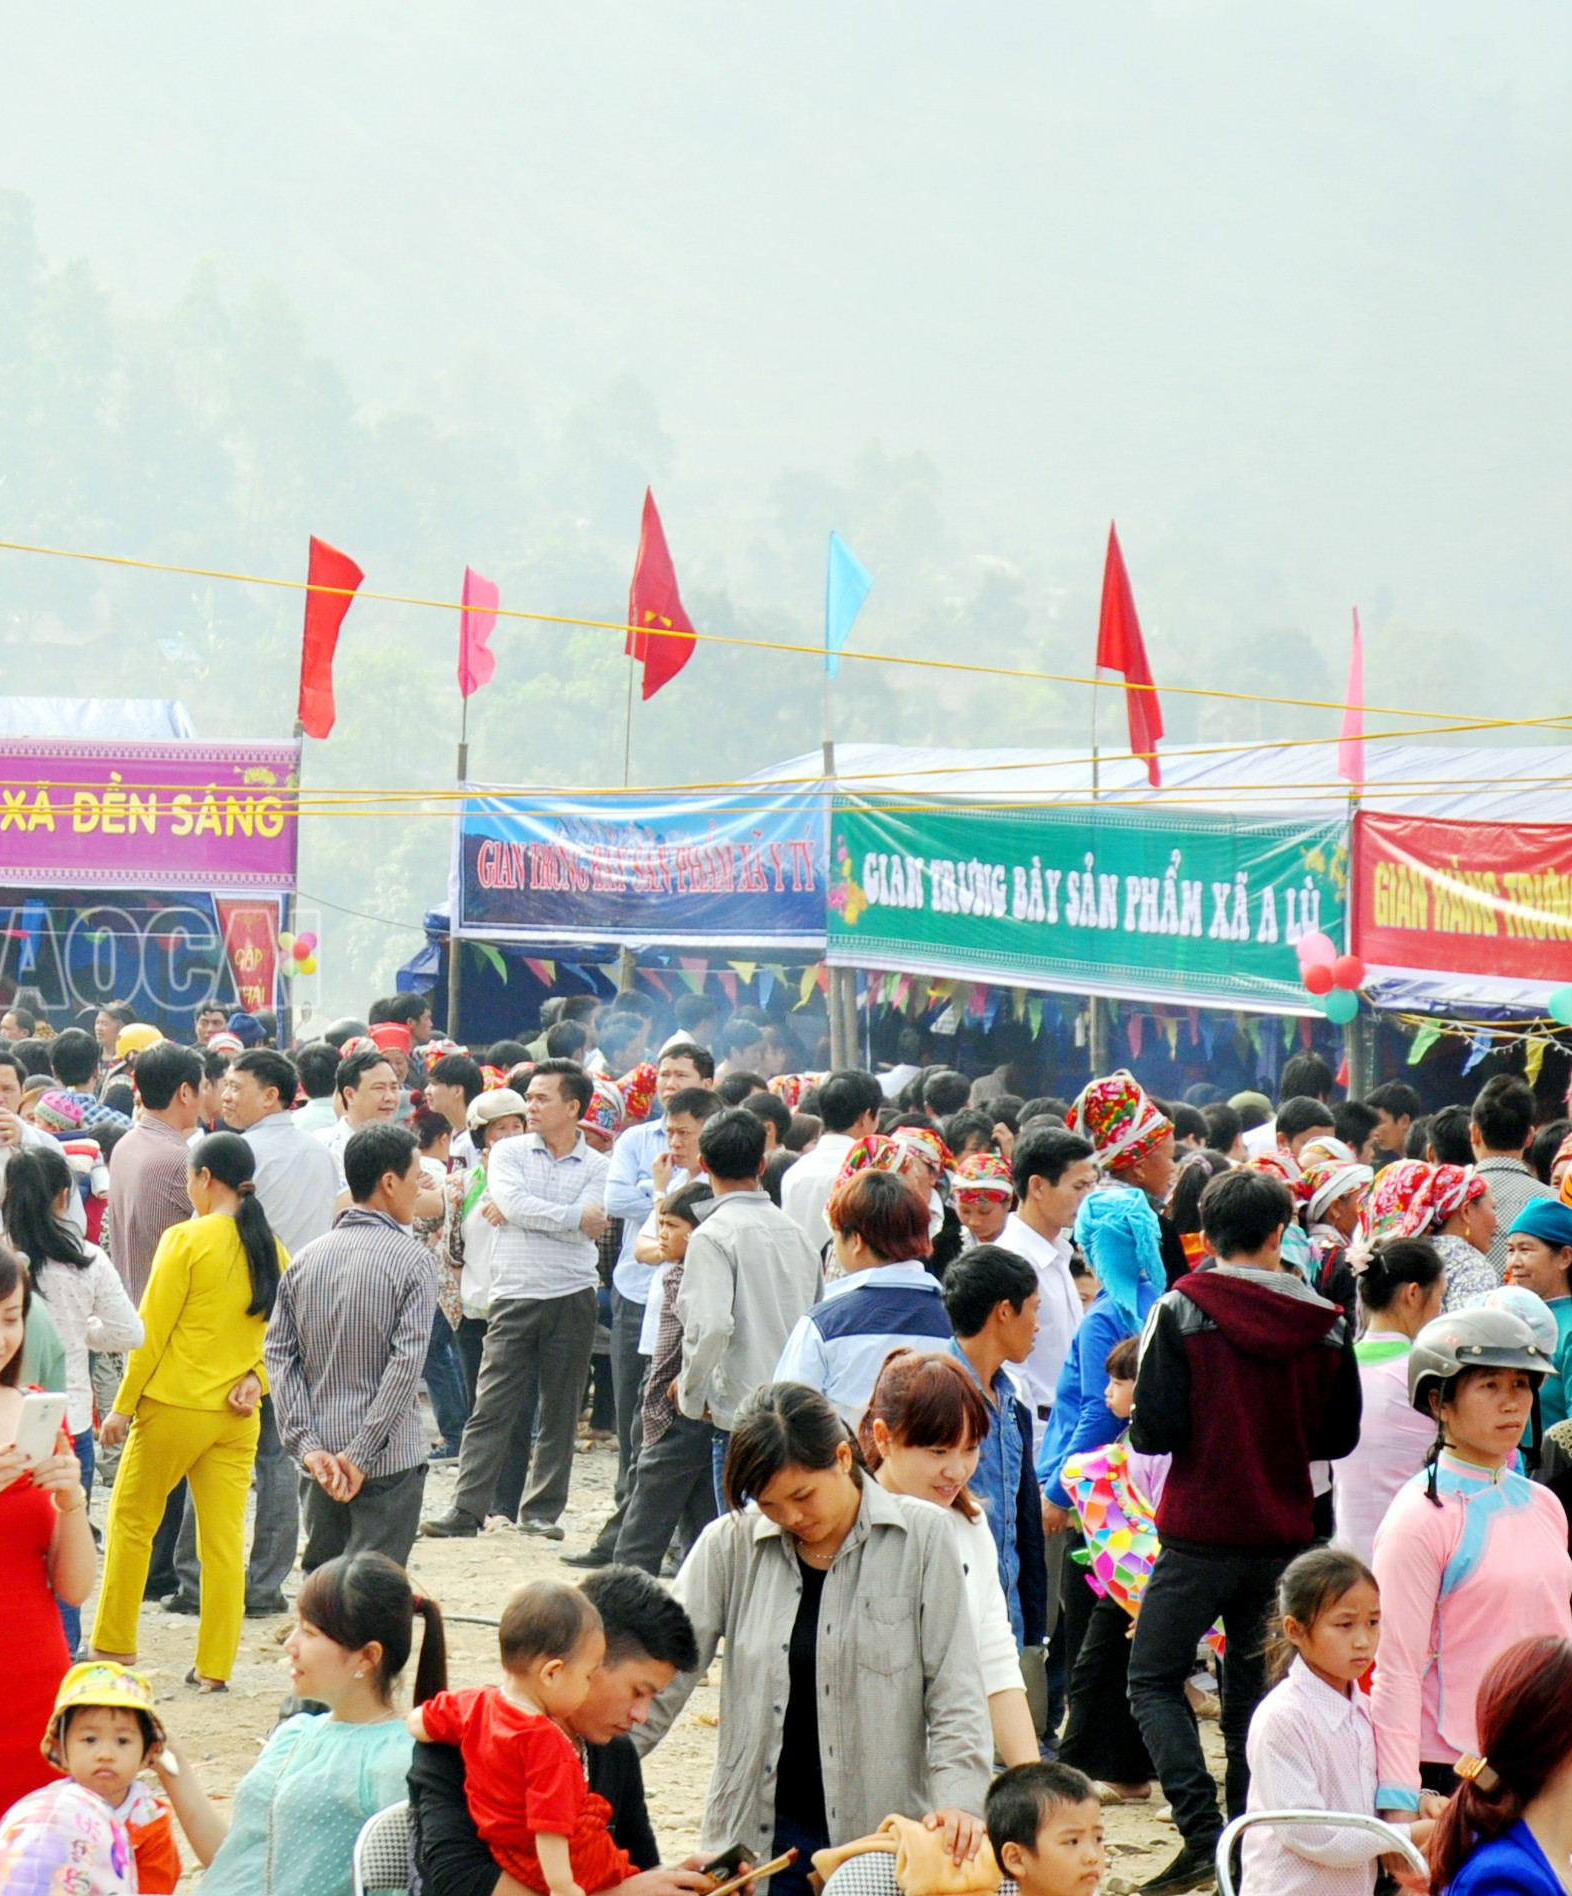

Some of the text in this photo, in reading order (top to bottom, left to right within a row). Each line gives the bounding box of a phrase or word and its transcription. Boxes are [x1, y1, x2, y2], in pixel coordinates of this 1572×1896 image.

[0, 780, 55, 832] XÃ
[171, 783, 285, 838] SÁNG
[478, 839, 526, 891] GIAN
[737, 828, 768, 892] XÃ
[769, 842, 785, 892] Y
[863, 848, 1321, 945] GIAN TRƯNG BÀY SẢN PHẨM XÃ A LÙ
[1374, 861, 1428, 931] GIAN
[1503, 867, 1572, 942] TRƯN
